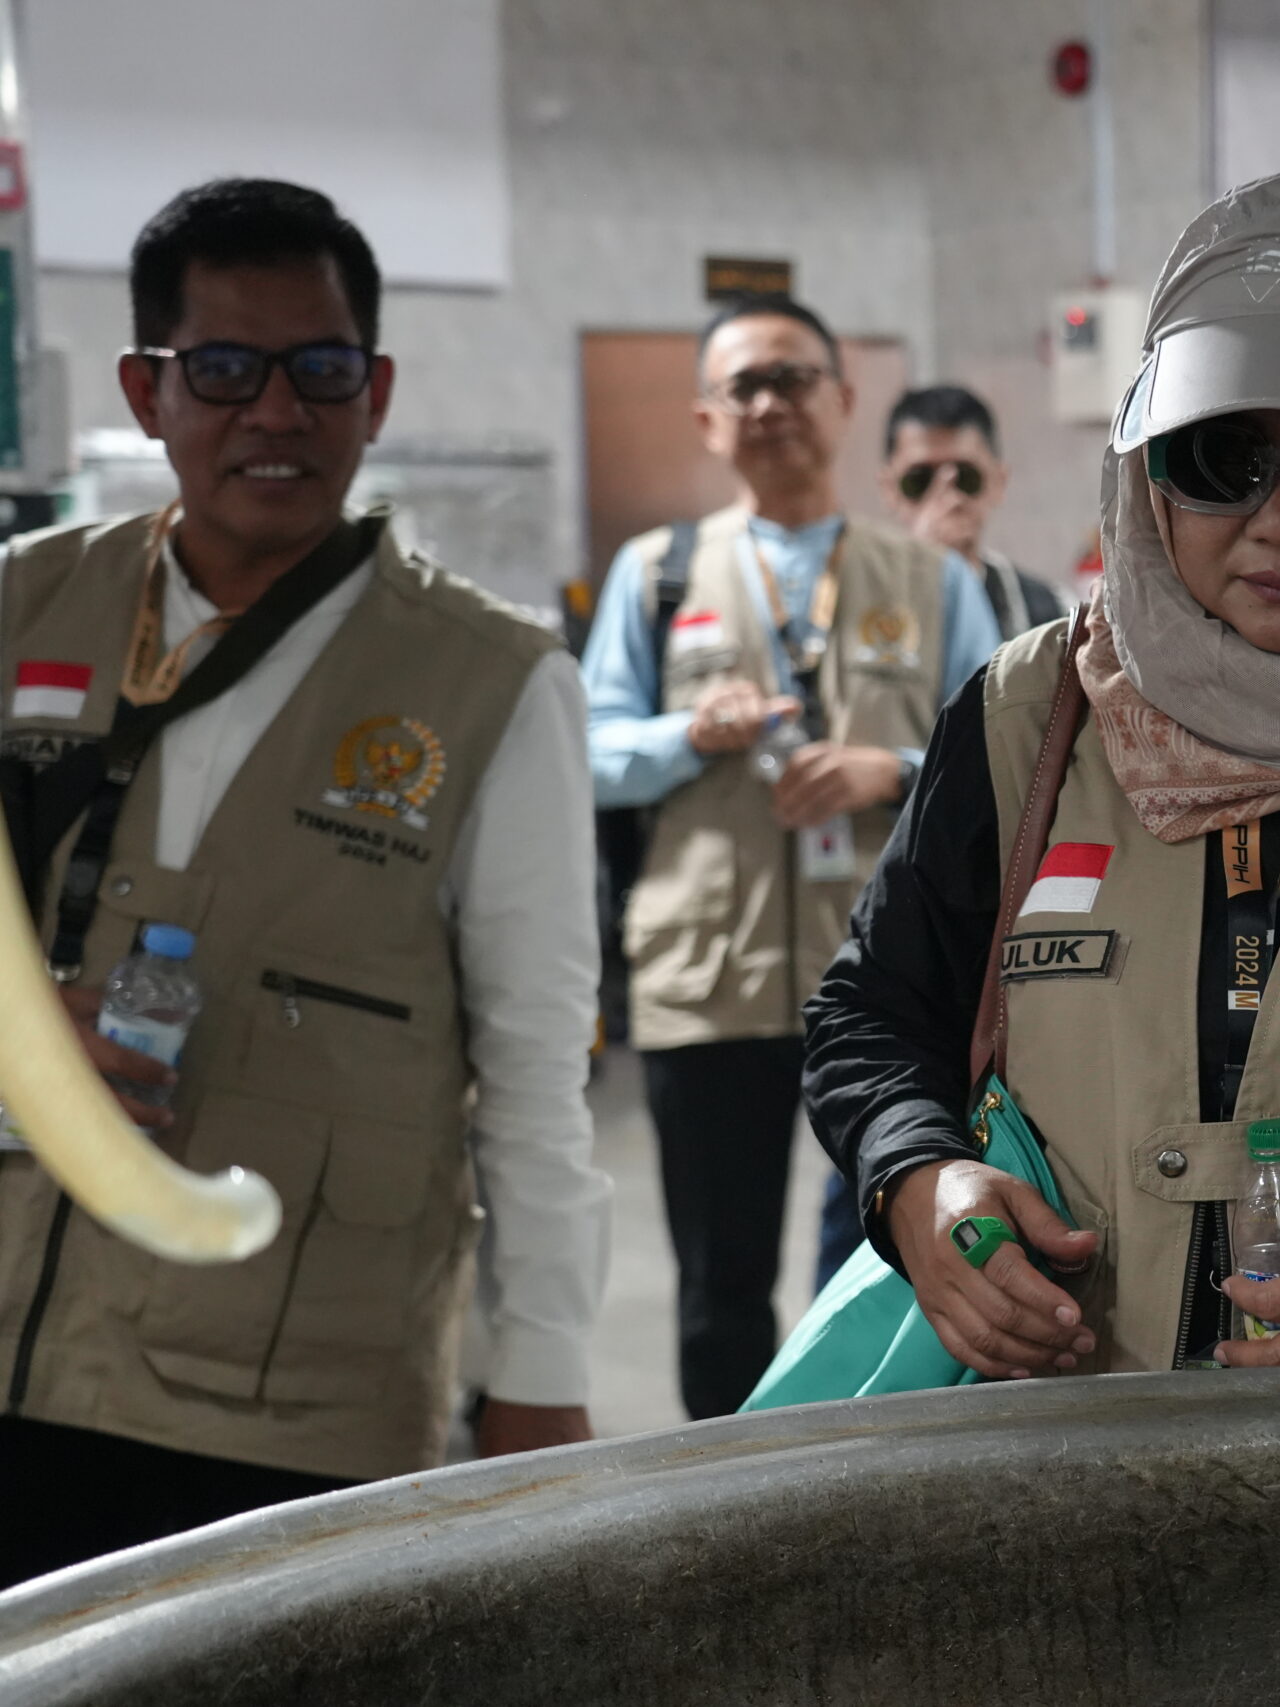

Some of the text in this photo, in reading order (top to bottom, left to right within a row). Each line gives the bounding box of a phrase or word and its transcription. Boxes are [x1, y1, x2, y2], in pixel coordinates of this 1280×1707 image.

[293, 807, 387, 848] TIMWAS
[1230, 824, 1251, 884] PPIH
[1235, 934, 1260, 986] 2024
